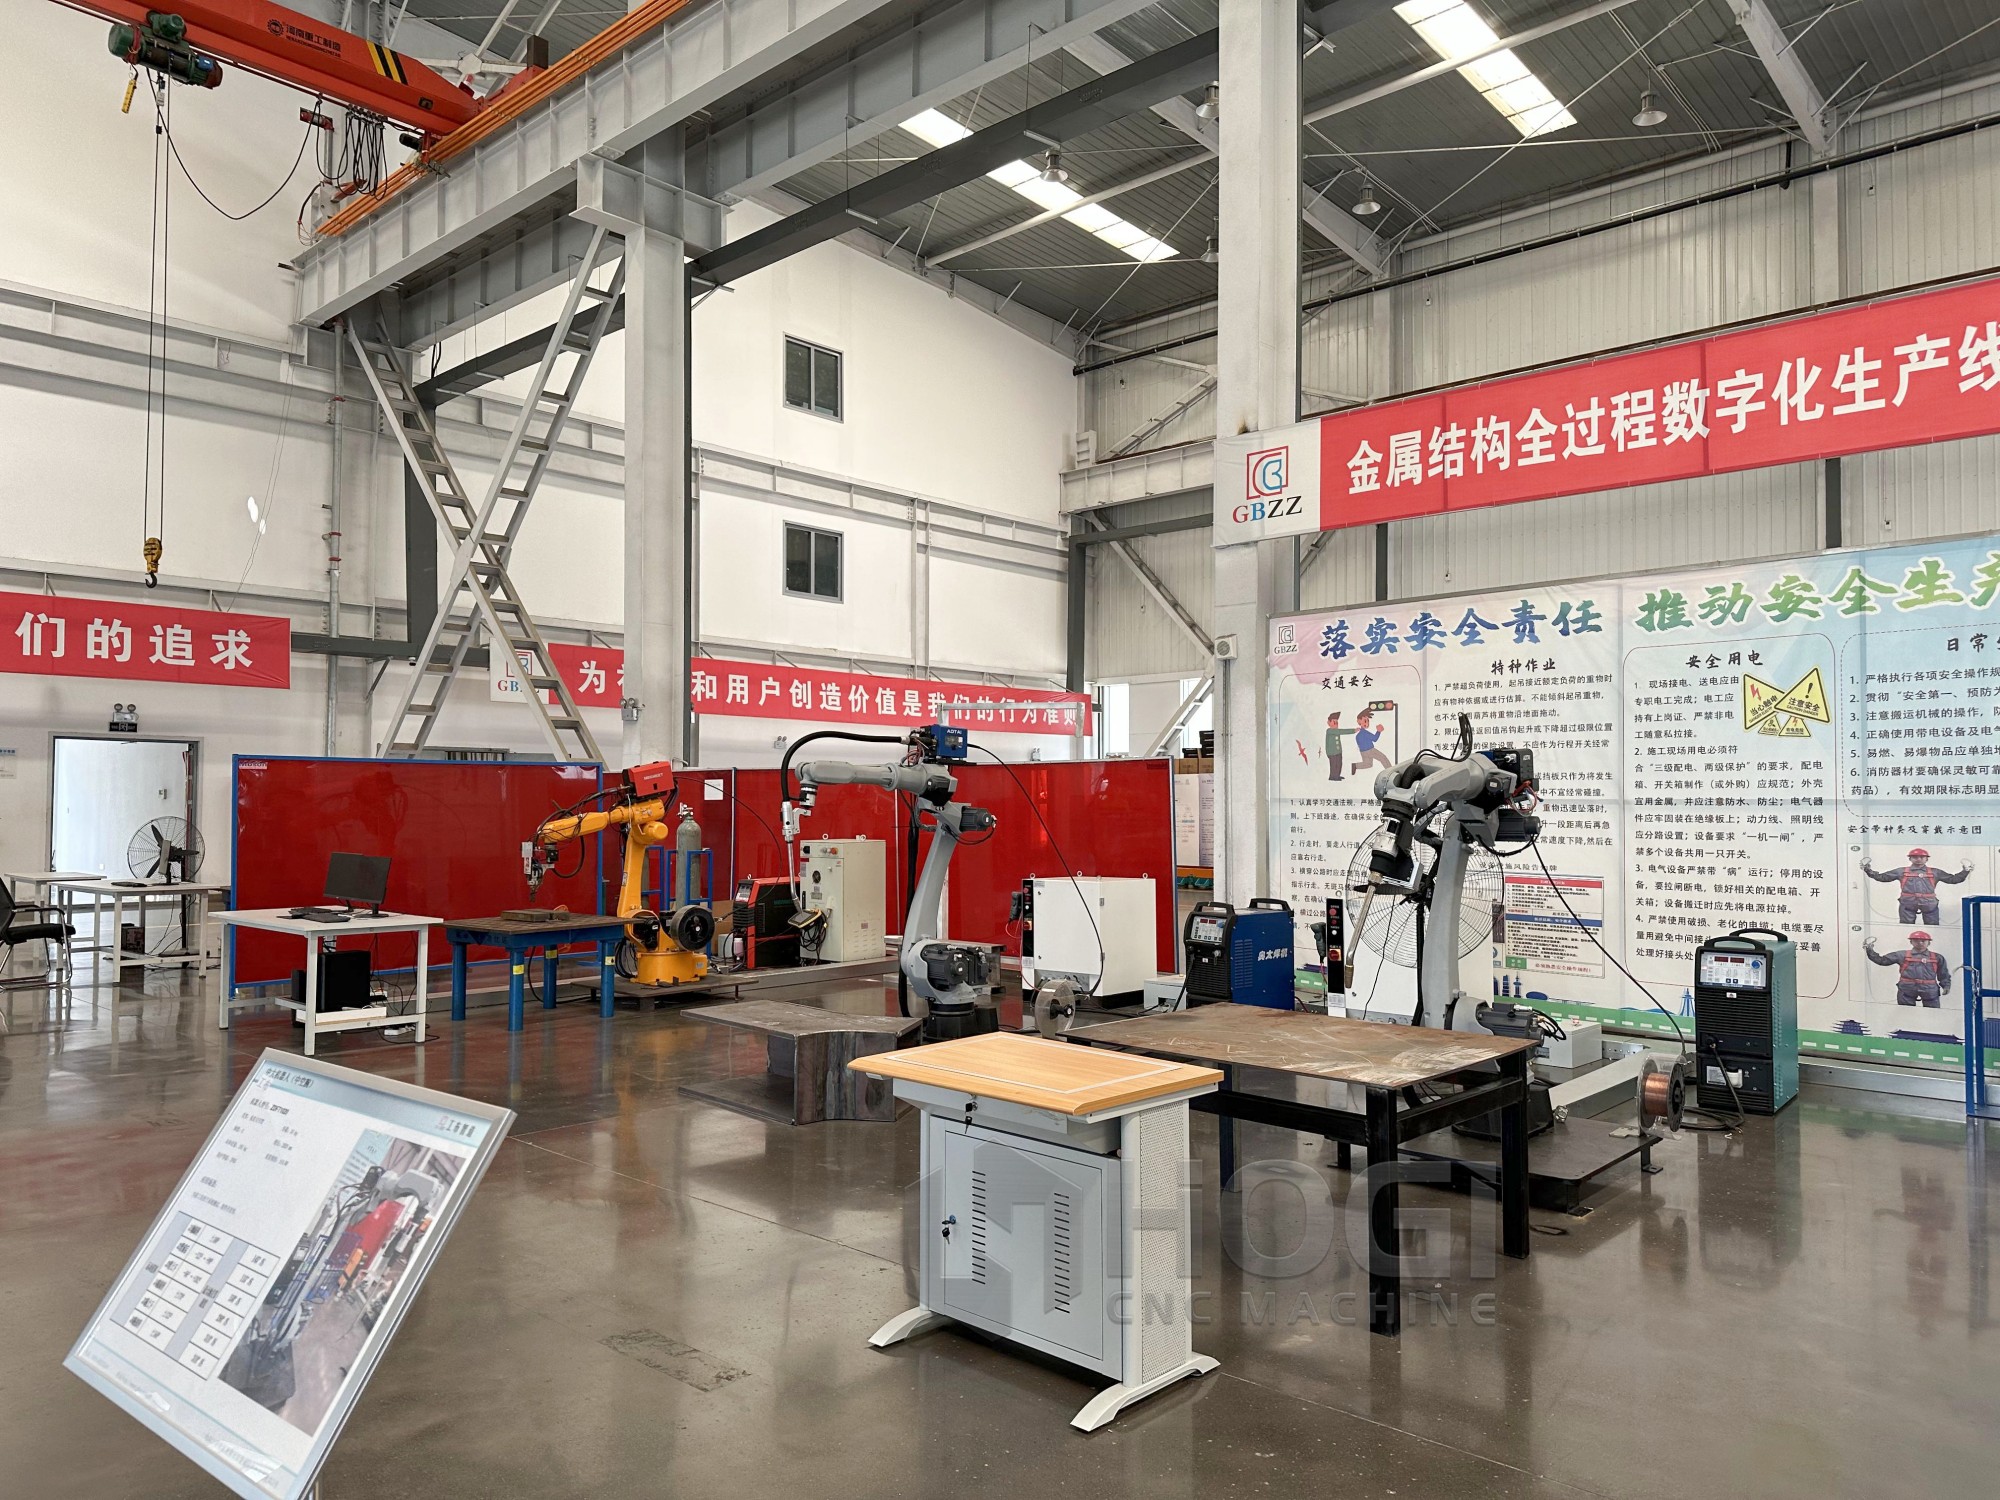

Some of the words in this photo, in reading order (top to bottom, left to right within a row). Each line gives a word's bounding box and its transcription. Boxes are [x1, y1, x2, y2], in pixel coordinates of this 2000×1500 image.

[1345, 320, 2000, 495] 金属结构全过程数字化生产线
[1232, 495, 1303, 523] GBZZ
[1317, 599, 1604, 660] 落实安全责任
[15, 611, 253, 670] 们的追求
[1274, 644, 1297, 655] GBZZ
[1491, 658, 1556, 675] 特种作业
[1686, 650, 1764, 669] 安全用电
[498, 680, 540, 693] GB
[578, 660, 624, 698] 为
[1322, 675, 1373, 690] 交通安全
[1788, 697, 1820, 712] 注意安全
[1434, 709, 1560, 723] 也不允用葫芦将重物沿地面拖动。
[1634, 729, 1698, 739] 工随意私拉接。
[1537, 787, 1605, 797] 中不宜经常碰撞。
[1635, 847, 1751, 859] 禁多个设备共用一只开关。
